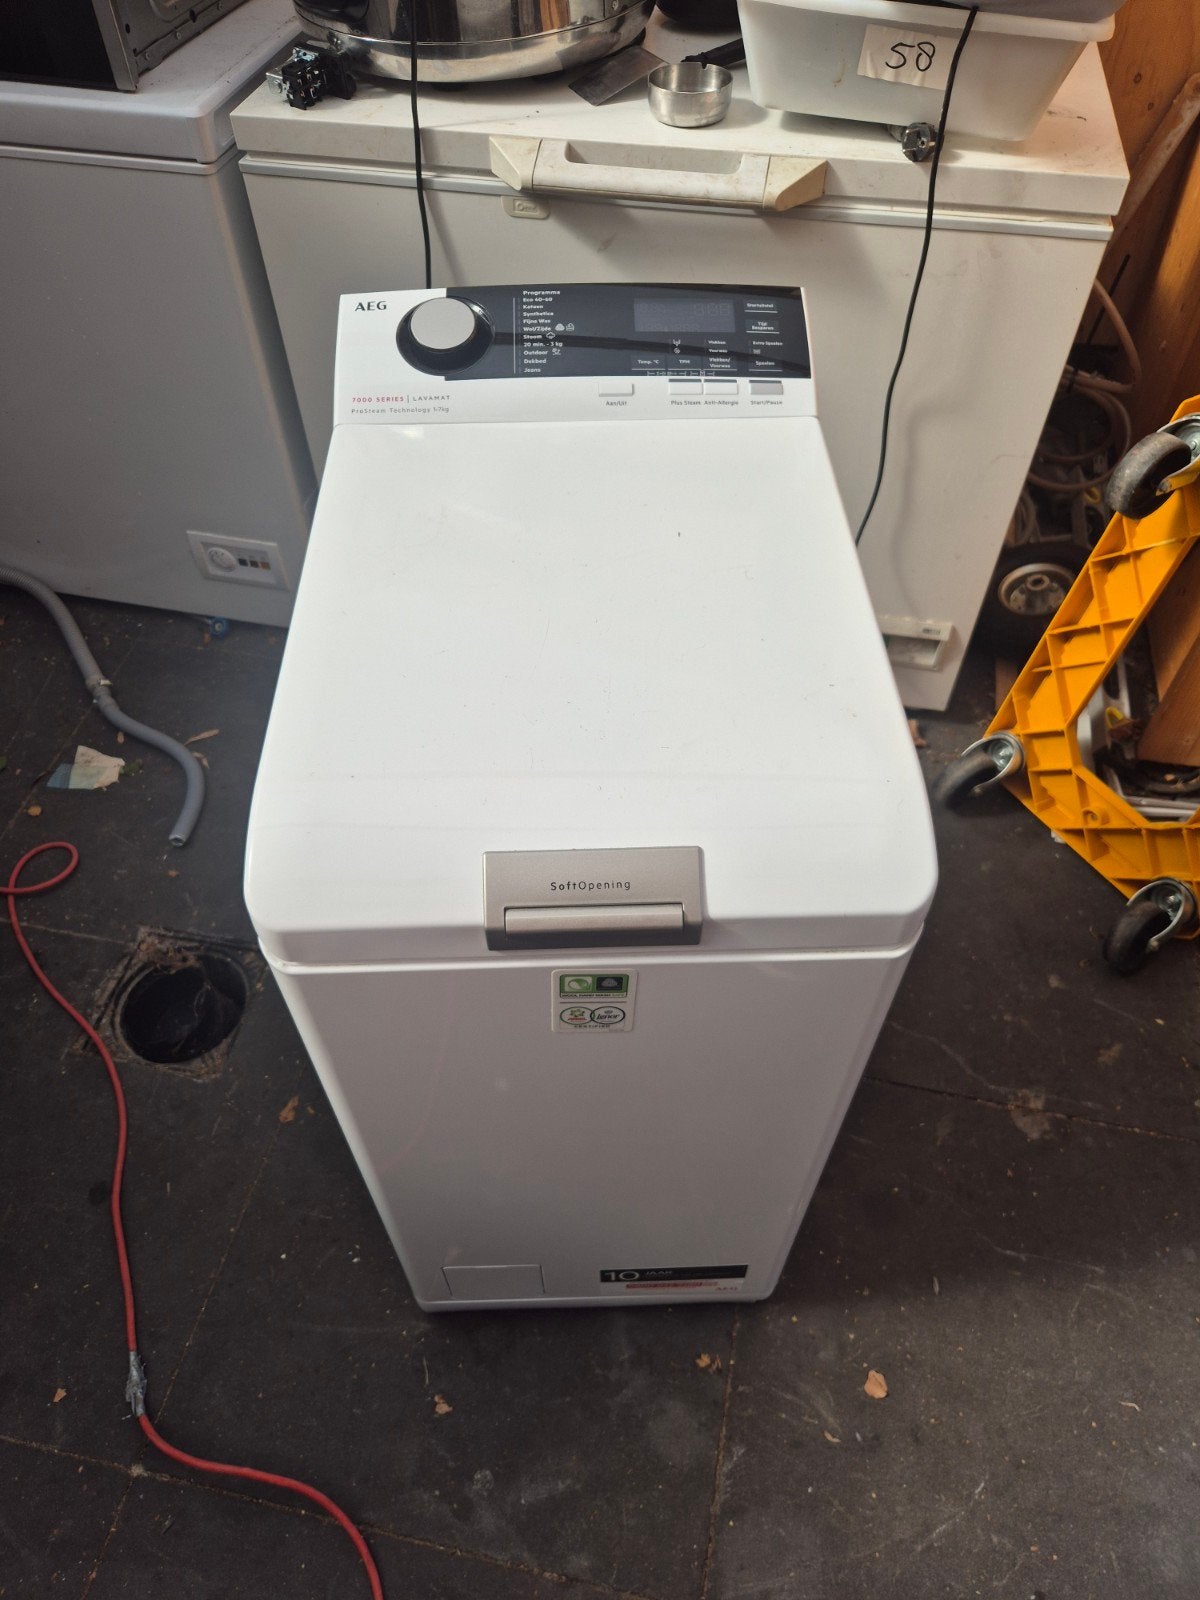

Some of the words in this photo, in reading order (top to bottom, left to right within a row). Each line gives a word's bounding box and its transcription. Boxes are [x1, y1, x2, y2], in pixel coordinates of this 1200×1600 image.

[885, 41, 936, 72] 58
[354, 300, 387, 312] AEG
[412, 394, 451, 402] LAVAMAT
[389, 405, 431, 414] Technology
[550, 880, 631, 891] SoftOpening
[604, 1270, 641, 1281] 10
